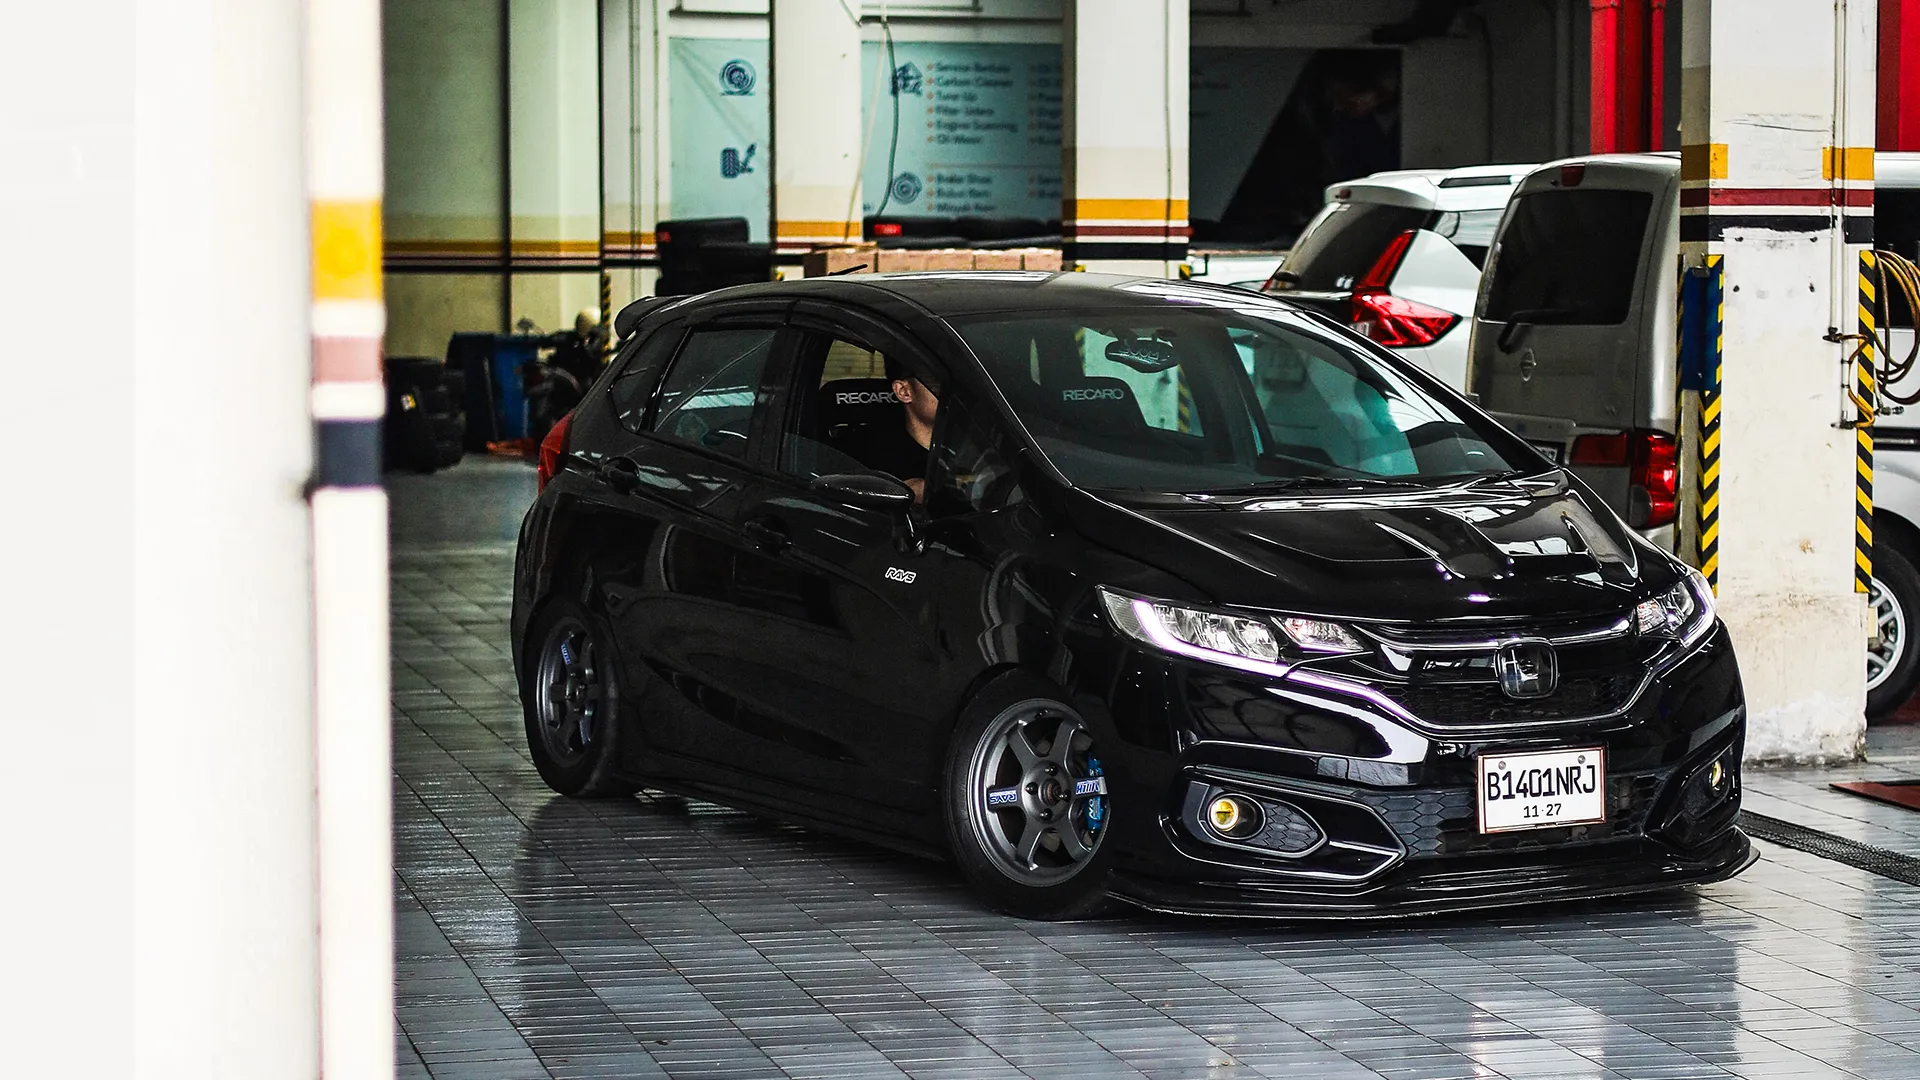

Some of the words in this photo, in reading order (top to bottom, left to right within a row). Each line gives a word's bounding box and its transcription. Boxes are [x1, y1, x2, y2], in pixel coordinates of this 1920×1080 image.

[1062, 388, 1124, 401] RECARO
[885, 566, 917, 584] RAYS
[989, 791, 1017, 805] RAYS
